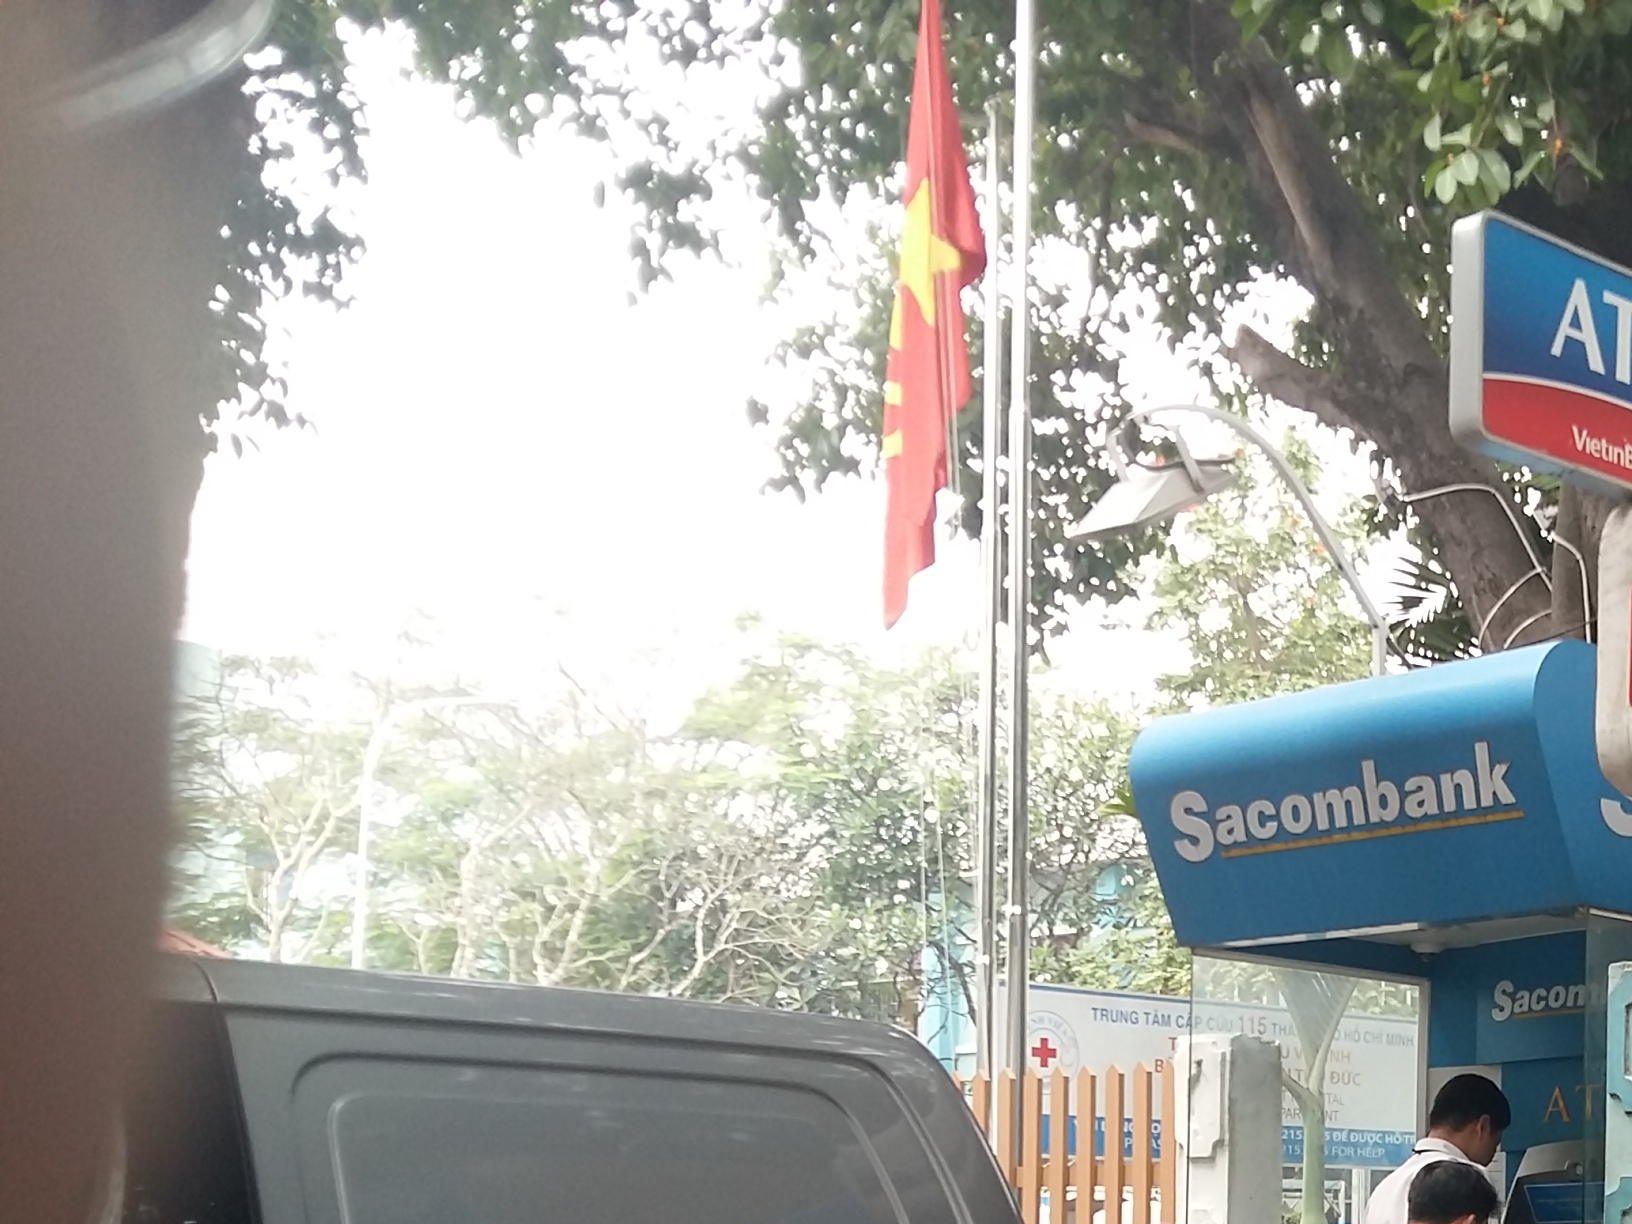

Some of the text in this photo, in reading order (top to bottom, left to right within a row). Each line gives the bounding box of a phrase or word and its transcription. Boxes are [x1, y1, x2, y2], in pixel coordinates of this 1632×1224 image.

[1170, 741, 1516, 862] Sacombank
[1091, 1007, 1139, 1026] TRUNG
[1144, 1009, 1172, 1028] TÂM
[1239, 1014, 1268, 1036] 115
[1385, 1032, 1414, 1047] MINH
[1330, 1068, 1362, 1087] ĐỨC
[1331, 1146, 1354, 1157] FOR
[1357, 1147, 1385, 1158] HELP
